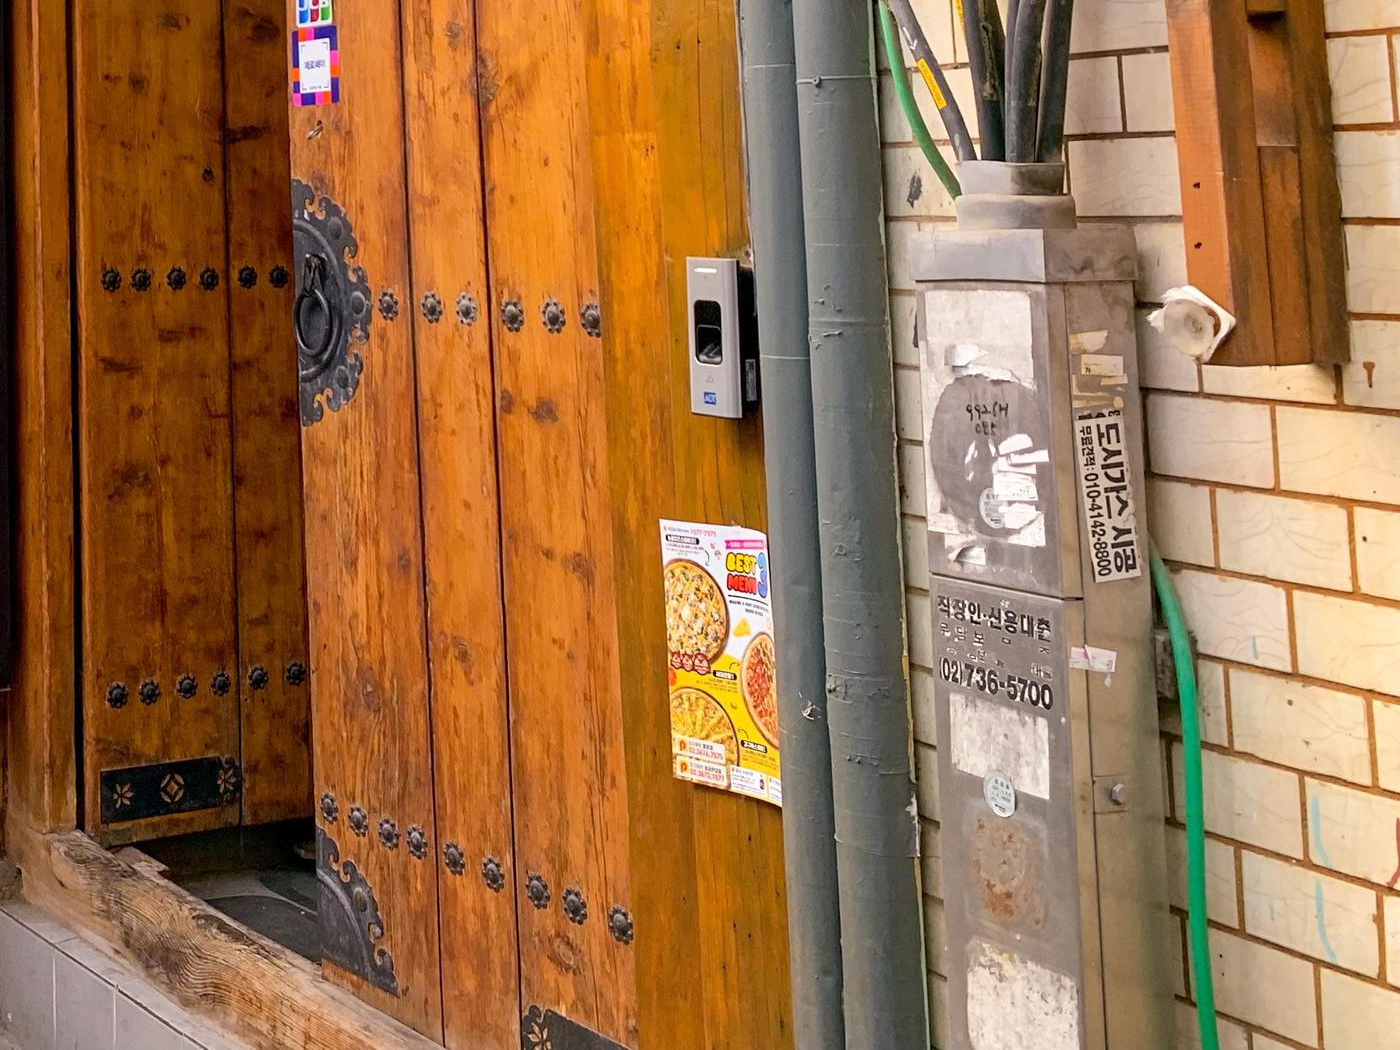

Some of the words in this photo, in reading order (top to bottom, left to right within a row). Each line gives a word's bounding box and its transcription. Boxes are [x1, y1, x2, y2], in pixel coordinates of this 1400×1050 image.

[1097, 423, 1129, 519] 도시가스
[1084, 473, 1112, 577] 010-4142-8800
[1111, 525, 1137, 573] 시공
[726, 552, 757, 575] BEST
